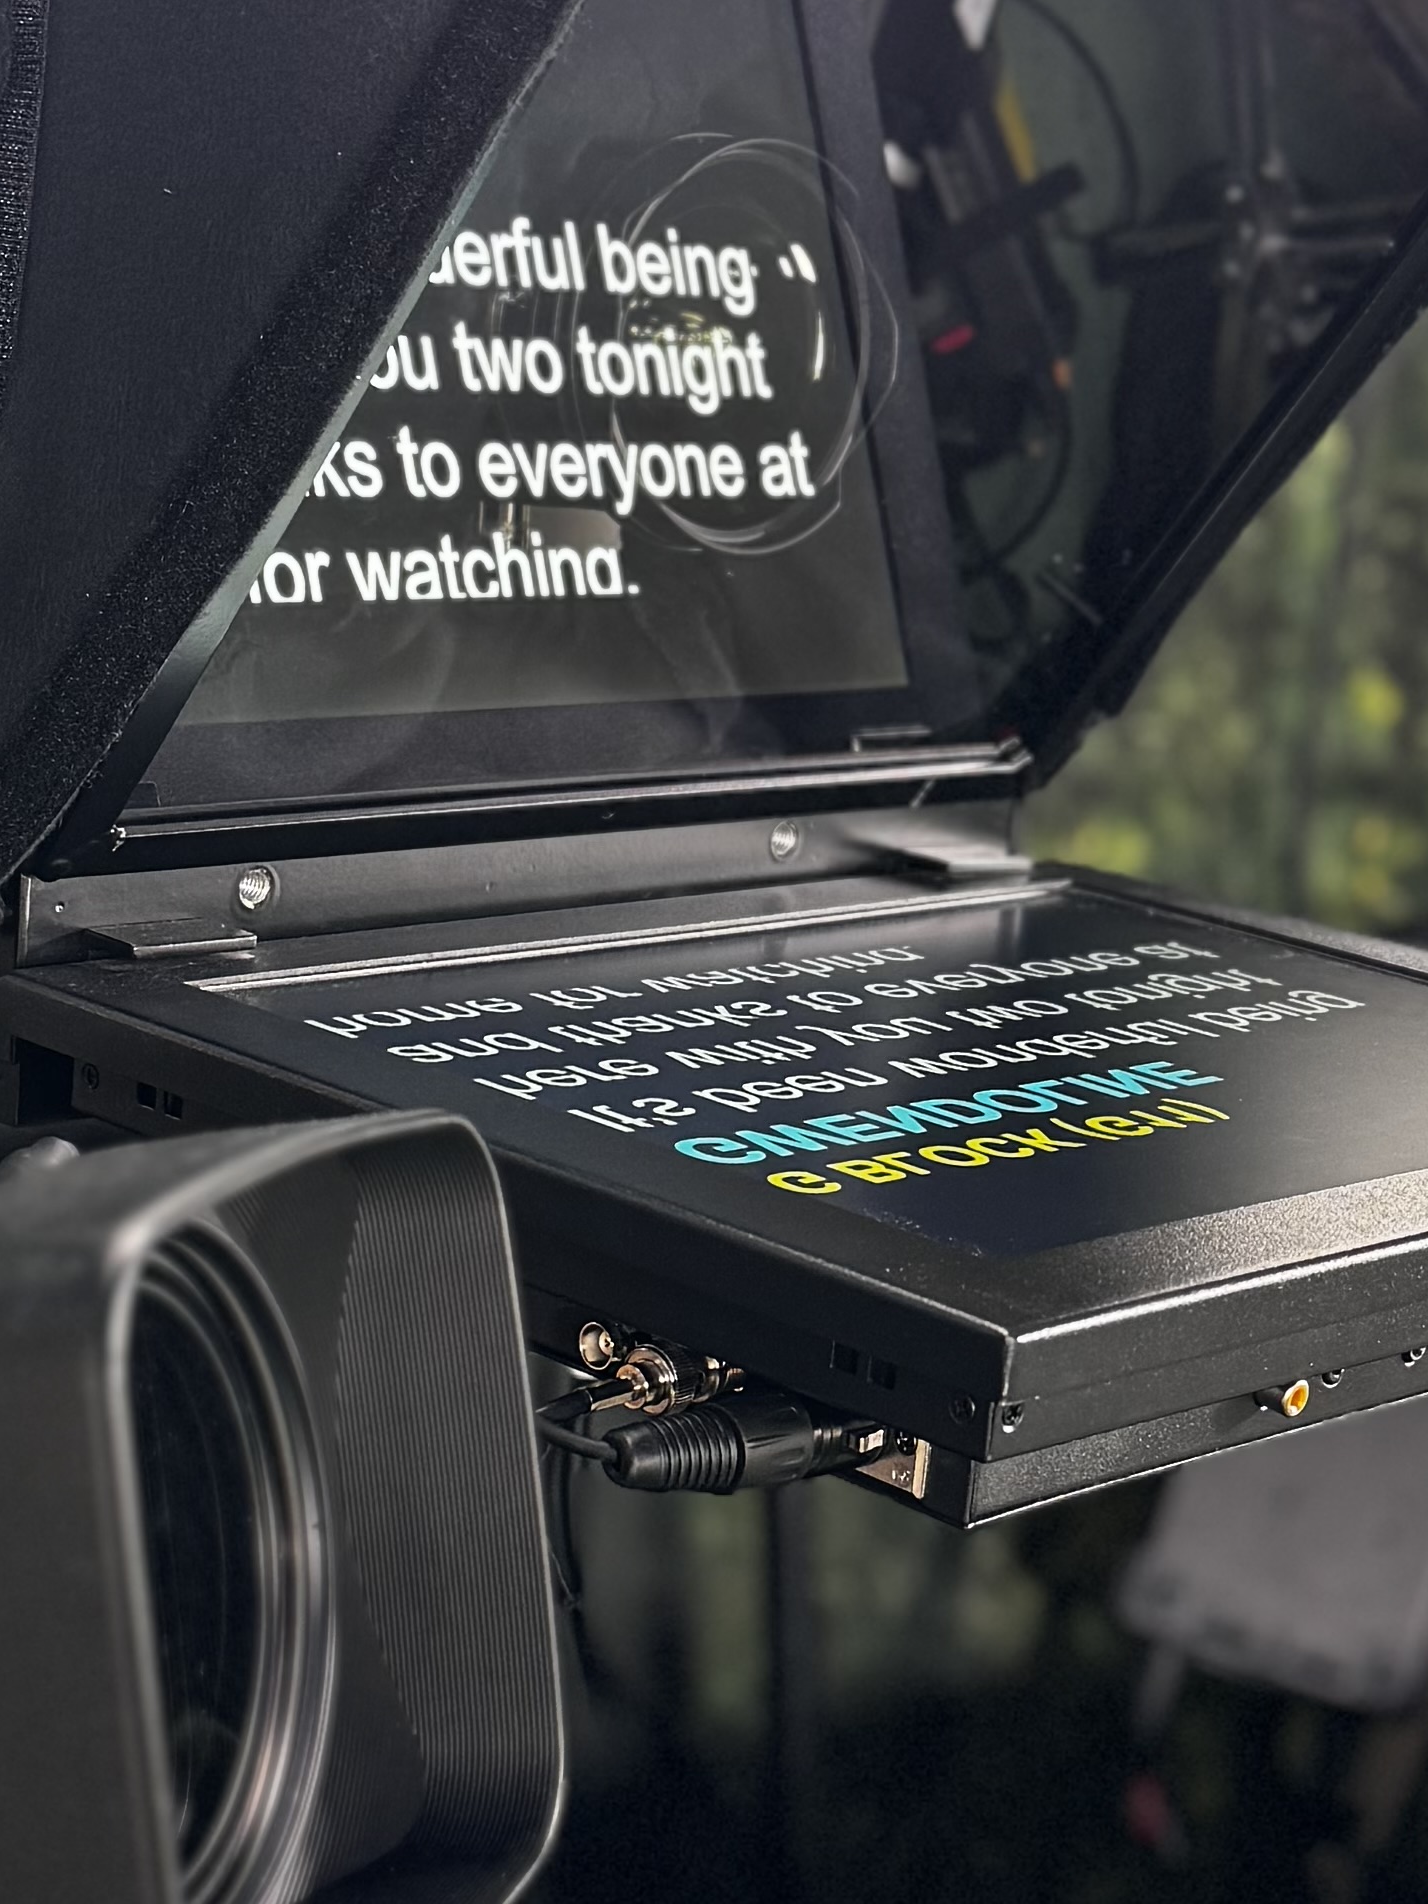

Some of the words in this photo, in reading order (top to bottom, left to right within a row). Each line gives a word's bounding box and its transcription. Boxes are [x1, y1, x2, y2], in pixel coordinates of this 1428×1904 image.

[596, 221, 758, 316] being
[452, 320, 564, 394] two
[575, 325, 774, 416] tonight
[395, 424, 461, 498] to
[478, 441, 746, 516] everyone
[758, 429, 816, 498] at
[249, 549, 332, 604] or
